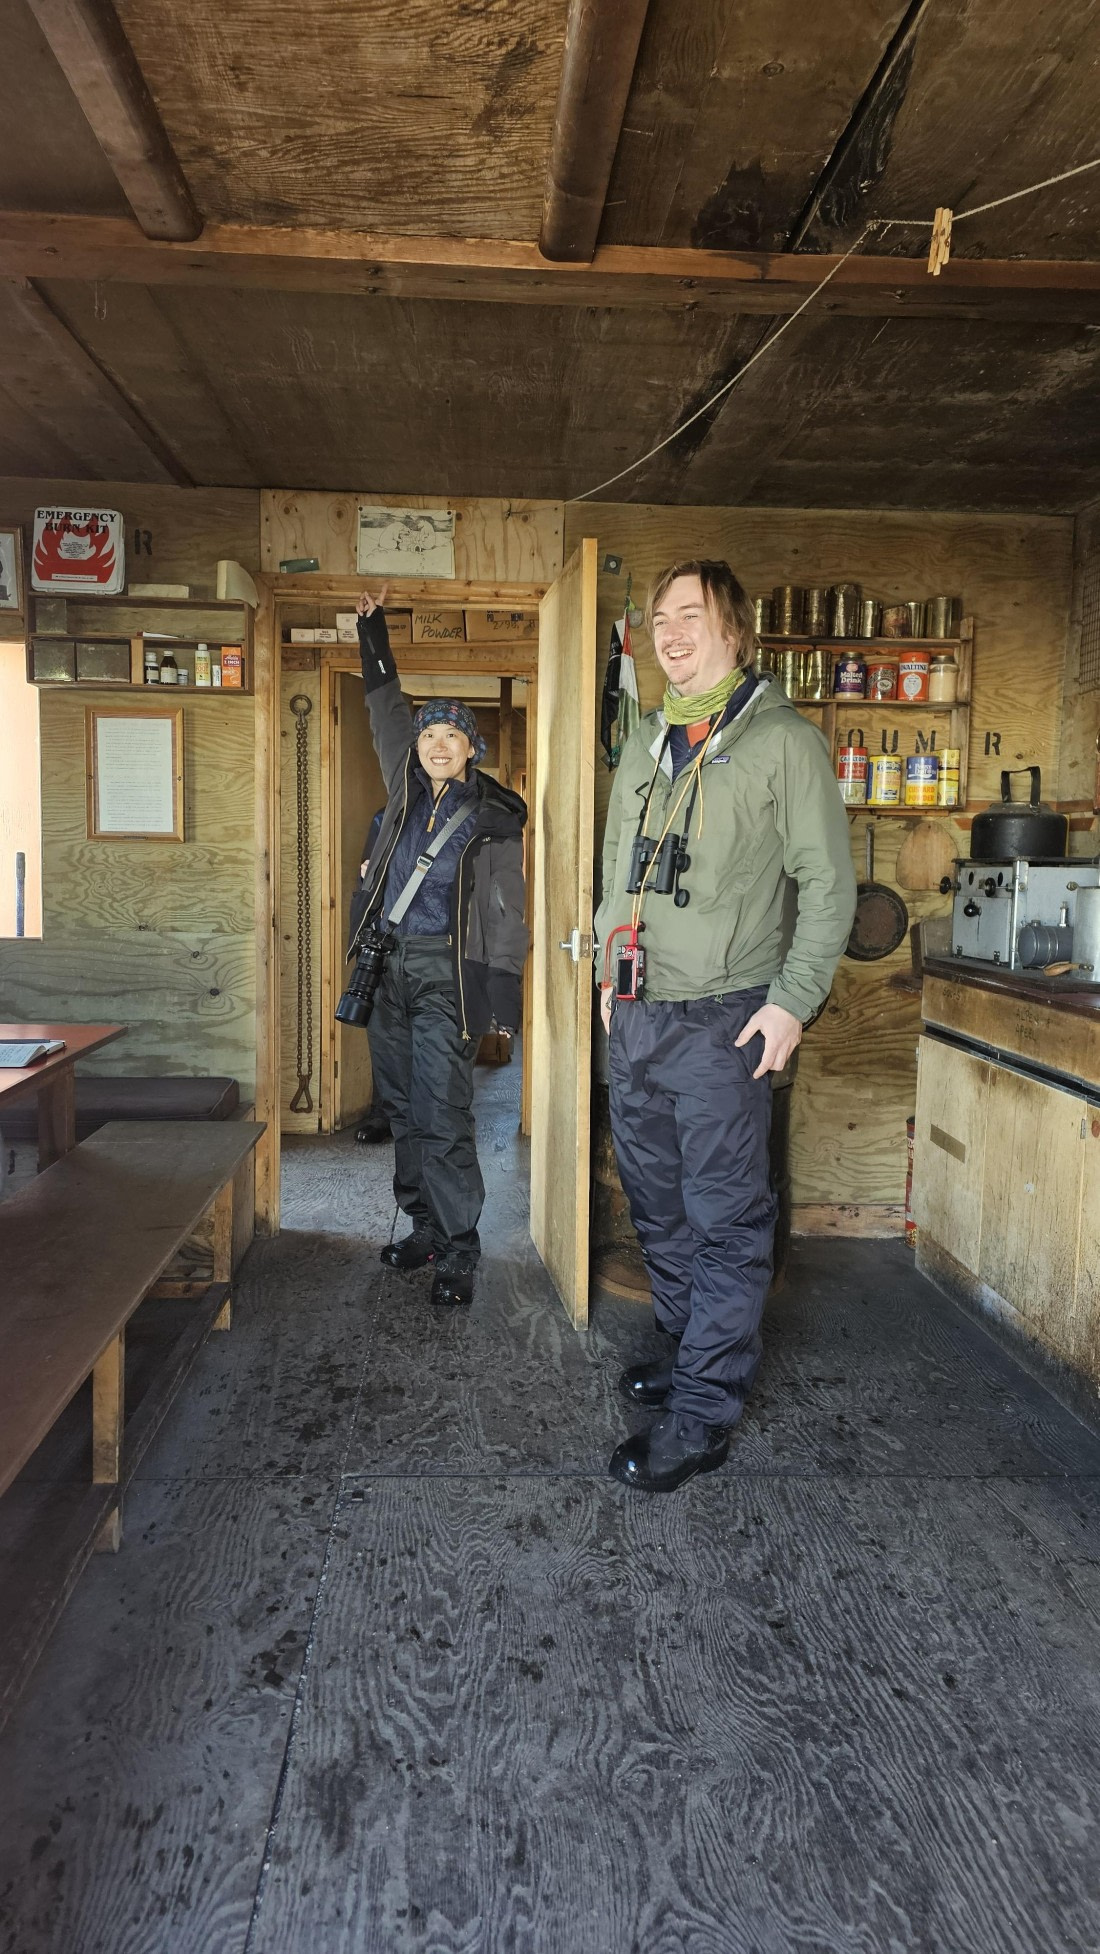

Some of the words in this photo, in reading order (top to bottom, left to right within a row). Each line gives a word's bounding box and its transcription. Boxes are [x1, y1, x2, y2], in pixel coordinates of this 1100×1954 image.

[36, 510, 117, 523] EMERGENCY
[45, 522, 81, 534] BURN
[86, 524, 108, 534] KIT
[414, 613, 443, 624] MILK
[420, 626, 463, 640] POWDER
[840, 671, 863, 679] Malted
